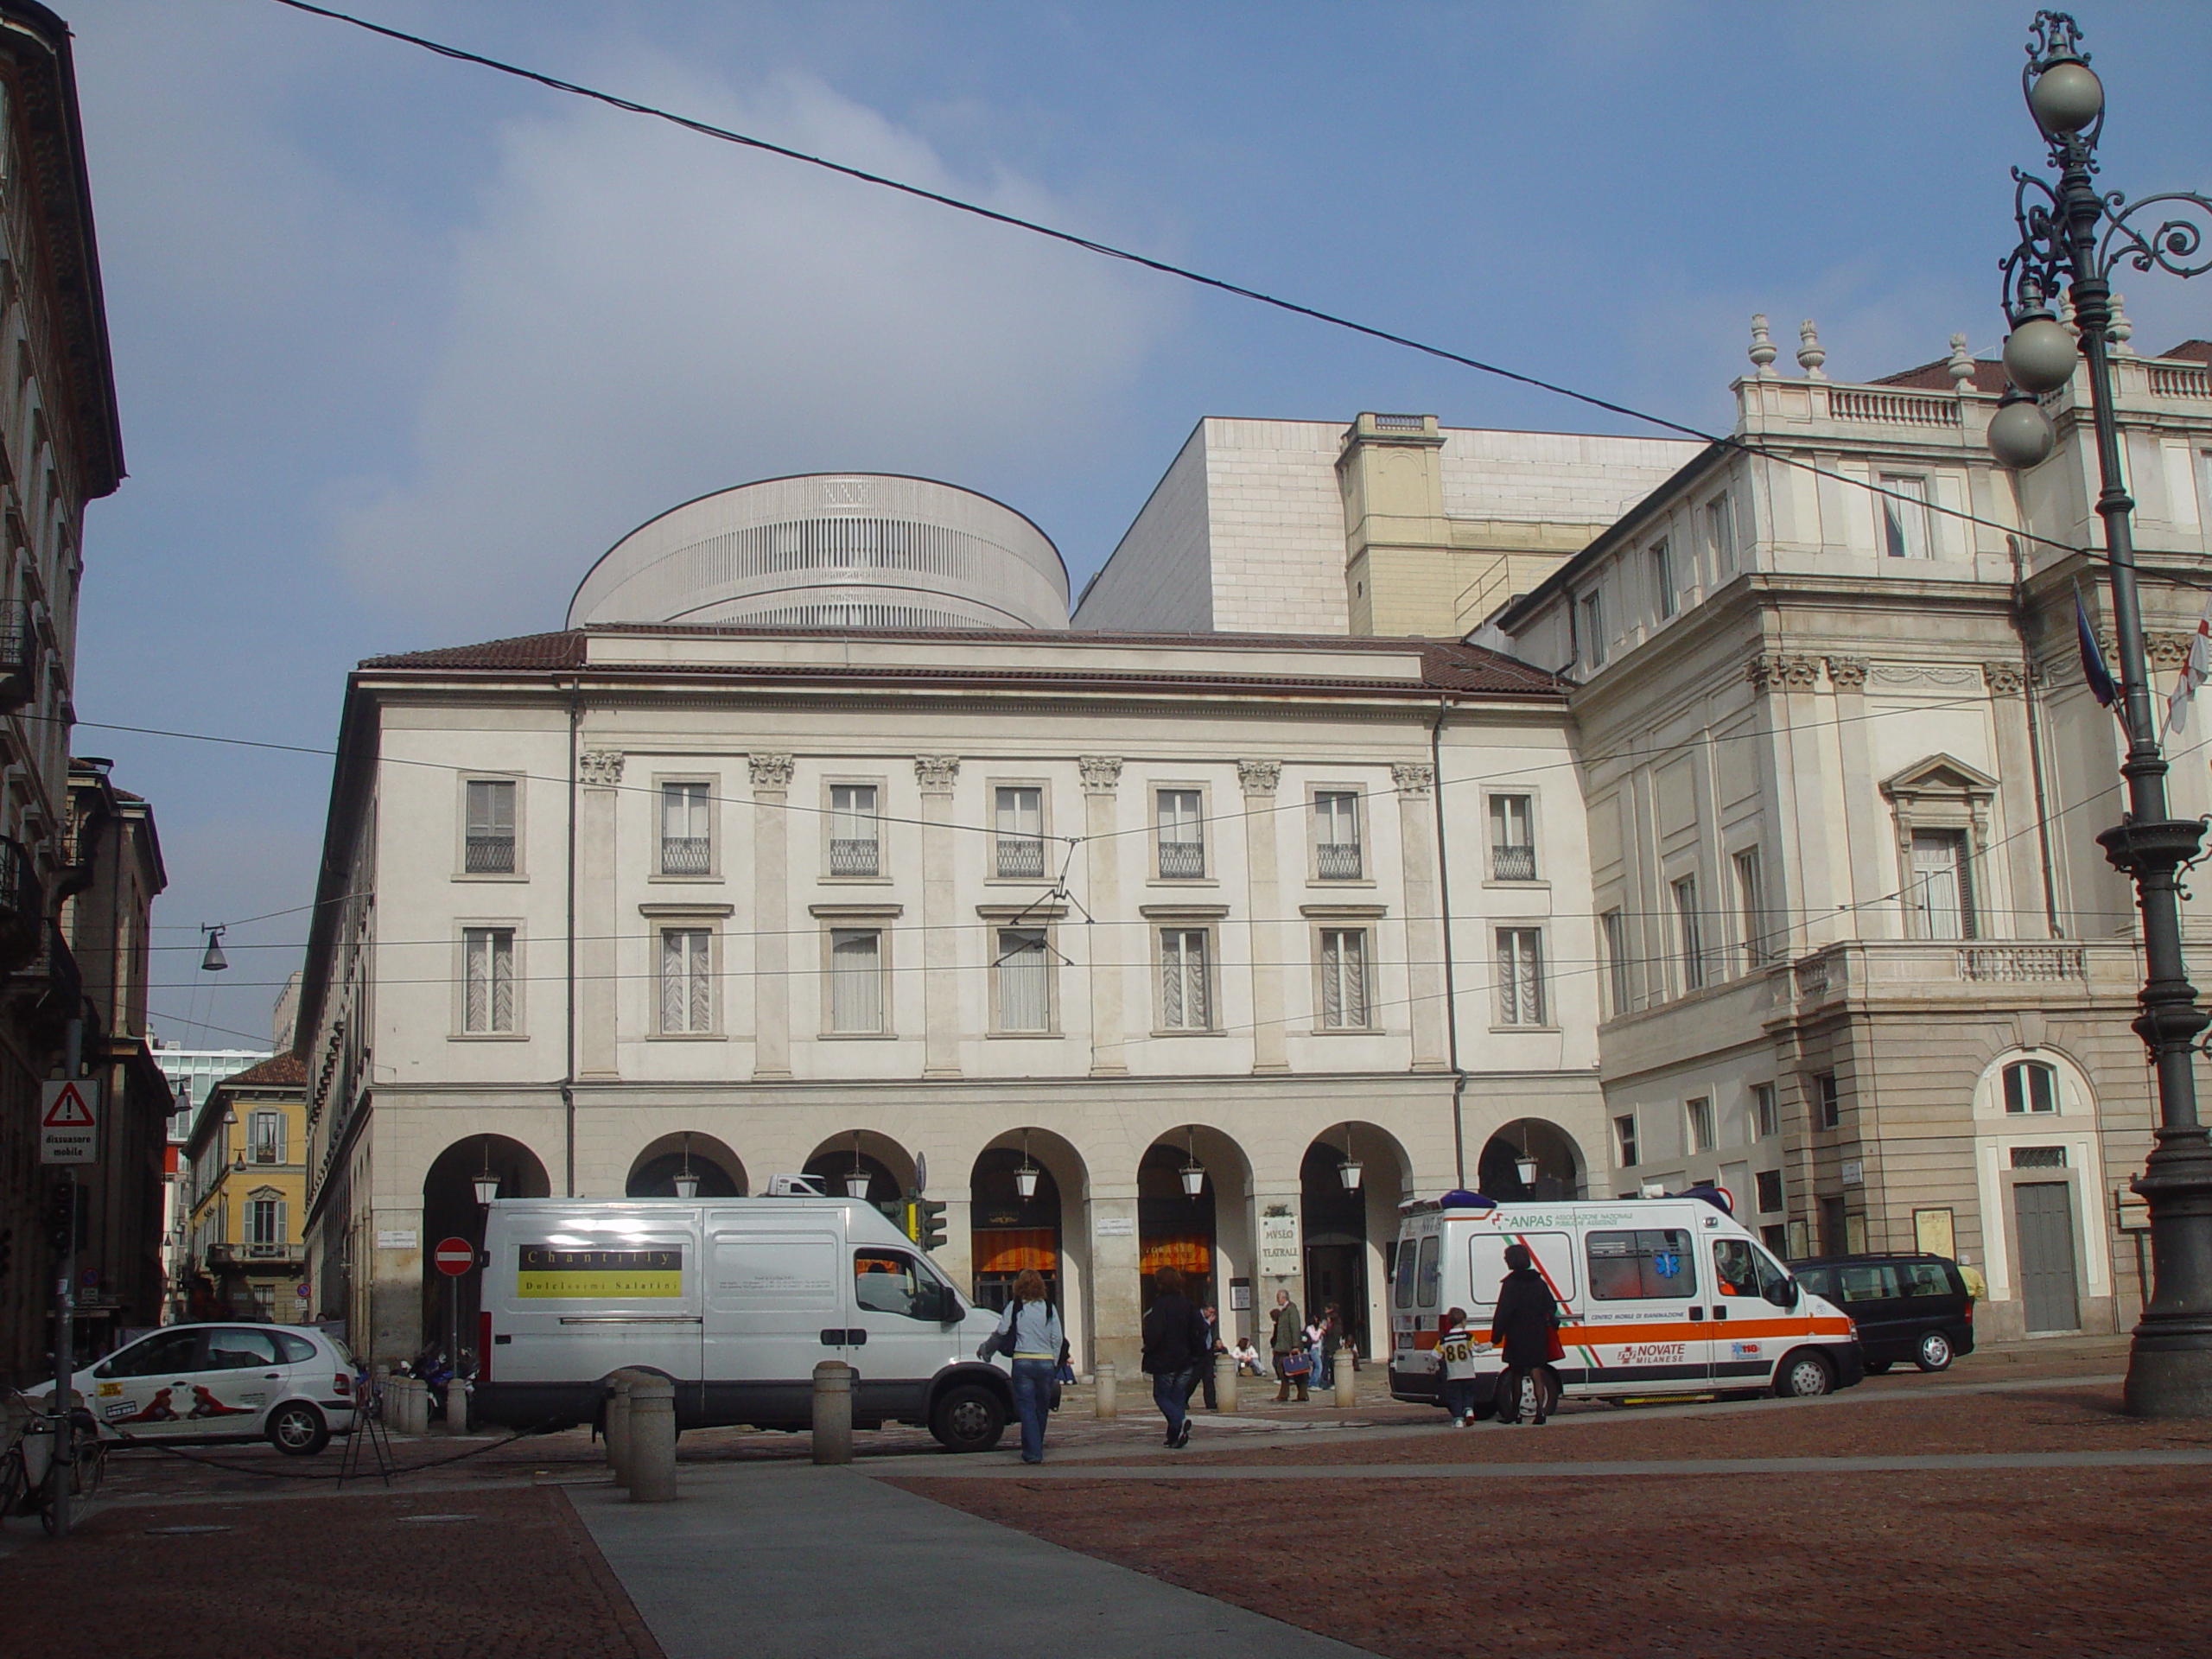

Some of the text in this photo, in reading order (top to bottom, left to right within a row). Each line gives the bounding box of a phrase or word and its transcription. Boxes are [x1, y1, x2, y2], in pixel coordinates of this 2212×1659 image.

[1510, 1215, 1553, 1227] ANPAS
[528, 1250, 669, 1265] Chantilly
[1262, 1248, 1298, 1257] TEATRALE
[526, 1281, 677, 1290] Dolcissimi Salatini
[1446, 1344, 1467, 1362] 86
[1637, 1344, 1686, 1356] NOVATE
